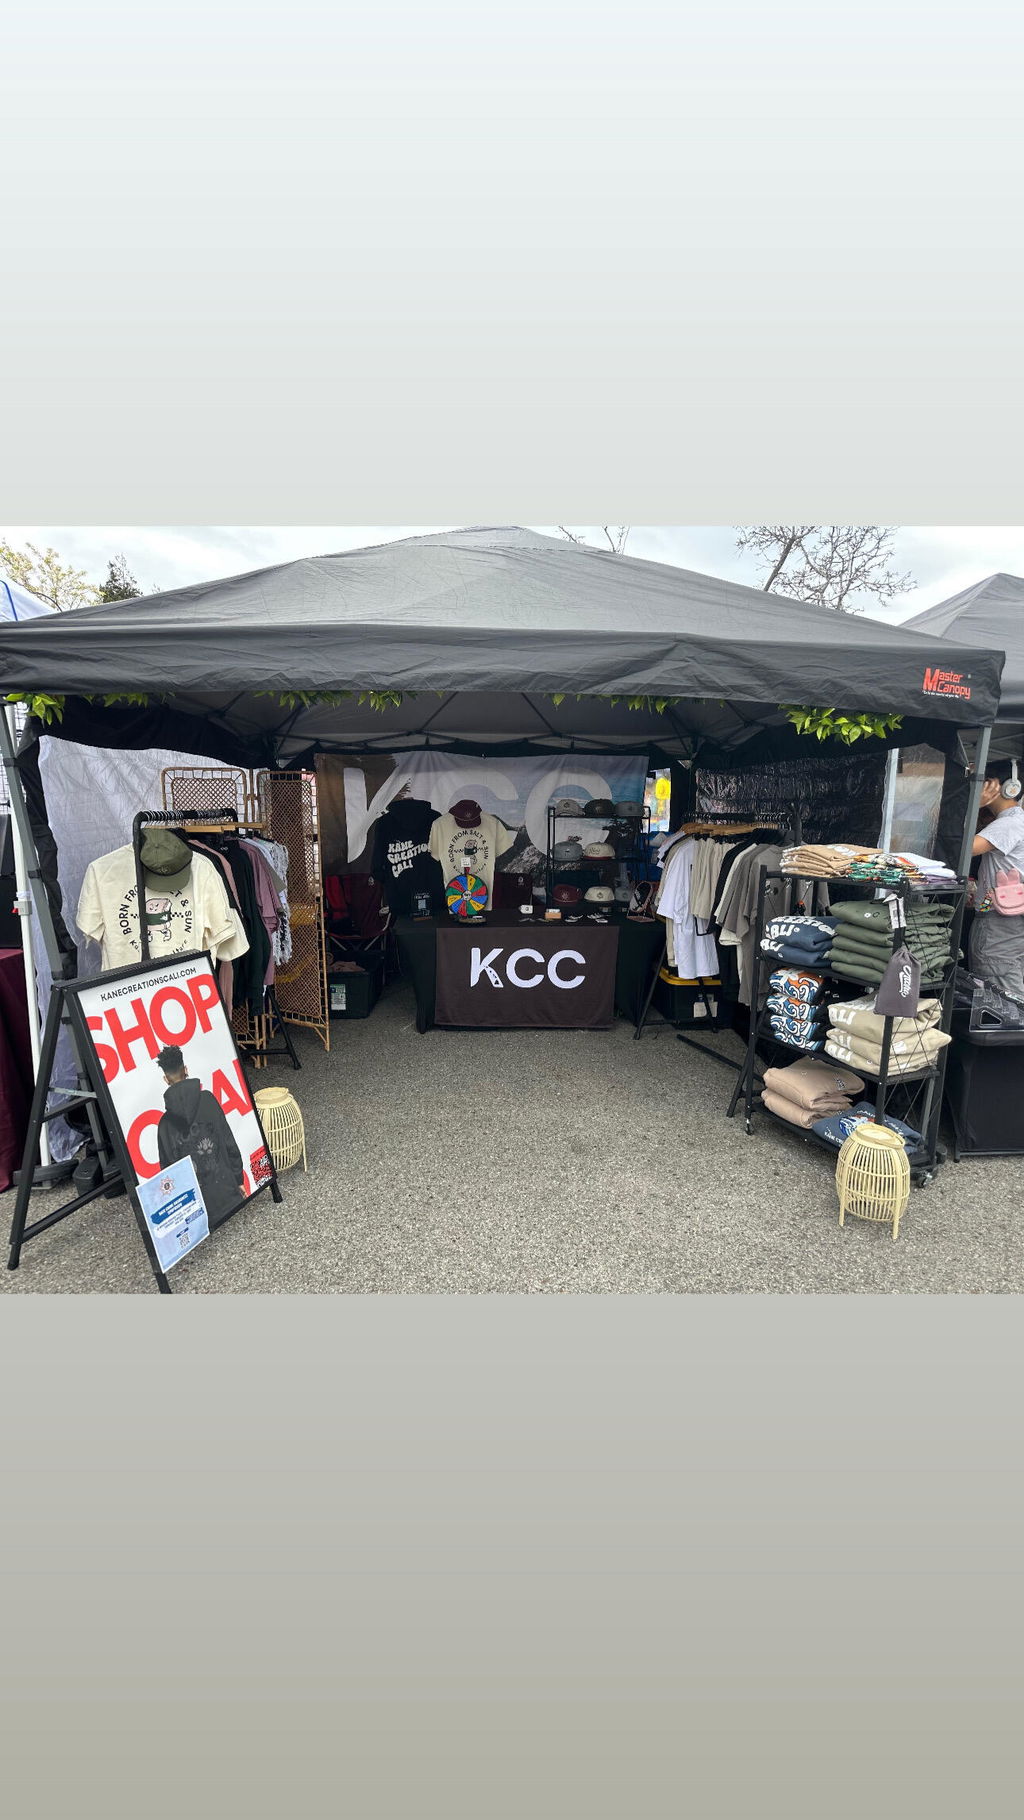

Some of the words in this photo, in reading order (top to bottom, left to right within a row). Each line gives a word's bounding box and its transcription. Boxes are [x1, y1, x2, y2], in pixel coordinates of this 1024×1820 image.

[923, 667, 964, 691] Master
[937, 681, 971, 700] Canopy
[387, 843, 428, 864] CREATIO
[391, 859, 414, 878] CALI
[124, 884, 139, 902] FRO
[180, 899, 189, 907] &
[118, 903, 132, 935] BORN
[184, 910, 192, 933] SUN
[471, 947, 586, 989] KCC
[100, 967, 197, 1002] KANECREATIONSCALI.COM
[85, 973, 221, 1084] SHOP
